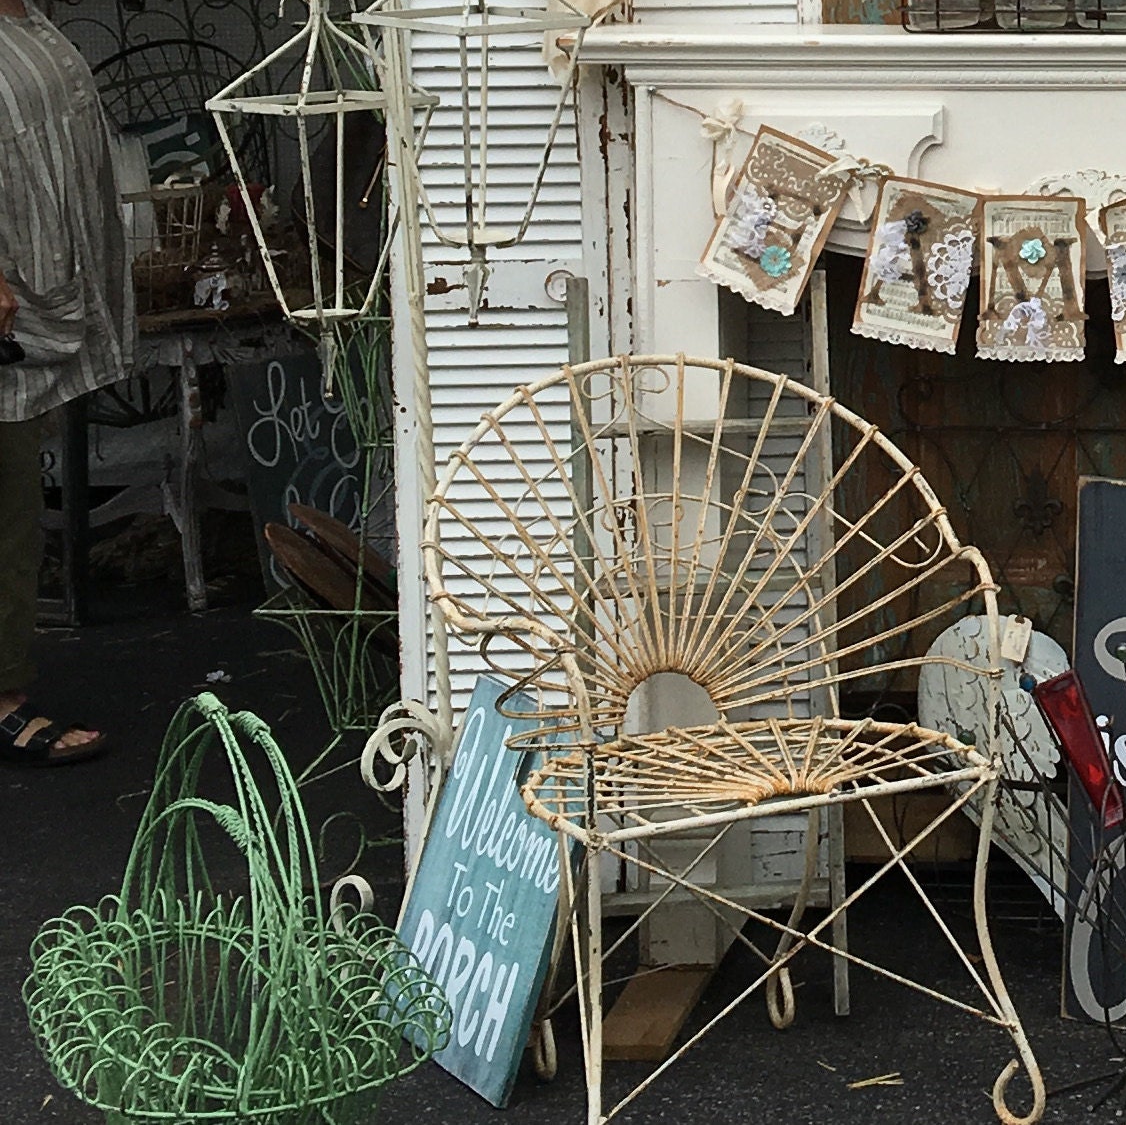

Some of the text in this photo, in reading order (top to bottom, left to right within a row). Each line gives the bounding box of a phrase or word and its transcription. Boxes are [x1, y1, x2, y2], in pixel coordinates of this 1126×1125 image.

[247, 360, 320, 468] Let
[445, 706, 562, 894] Welcome
[447, 861, 516, 947] To The
